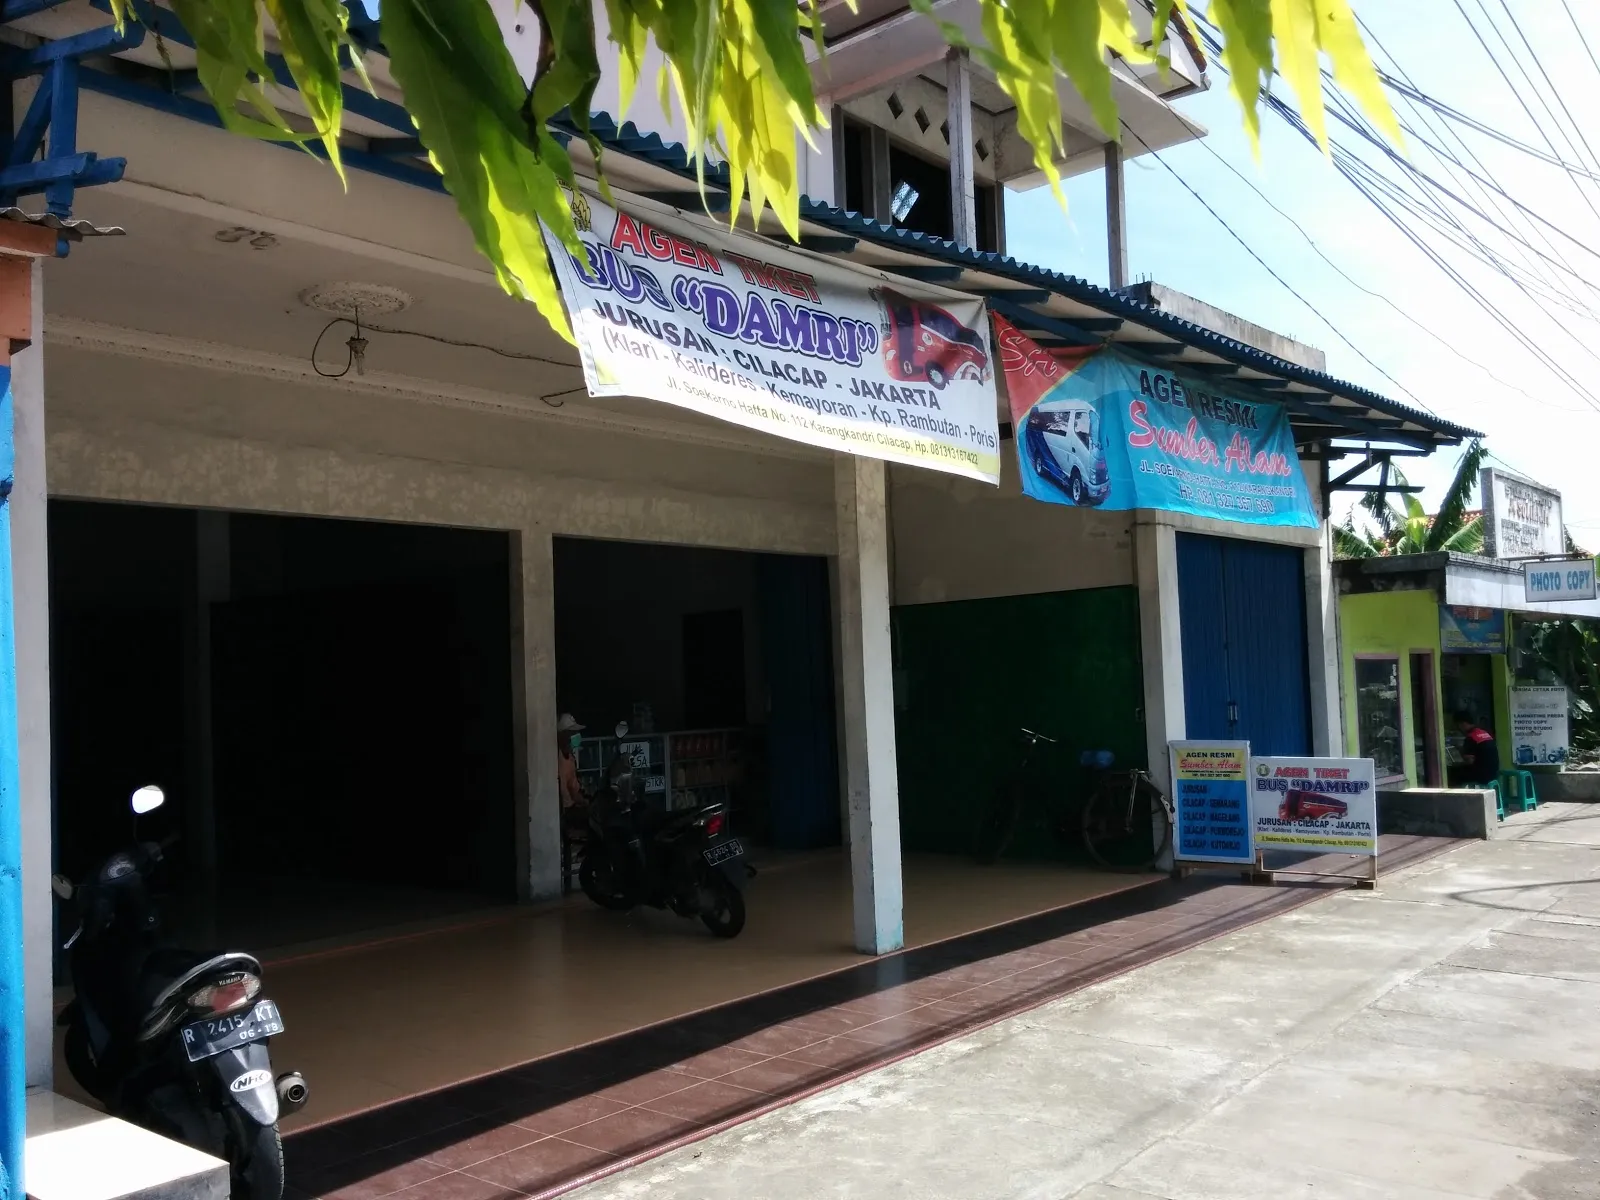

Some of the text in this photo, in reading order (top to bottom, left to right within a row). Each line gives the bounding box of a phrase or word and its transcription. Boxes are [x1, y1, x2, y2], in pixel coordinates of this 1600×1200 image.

[569, 240, 675, 312] BUS
[610, 209, 822, 305] AGEN TIKET
[592, 299, 718, 357] JURUSAN
[733, 349, 827, 389] CILACAP
[849, 377, 941, 410] JAKARTA
[602, 325, 659, 361] (Klari
[671, 350, 757, 391] Kalideres
[765, 381, 858, 418] Kemayoran
[868, 403, 895, 428] Kp.
[897, 408, 961, 438] Rambutan
[1139, 368, 1260, 430] AGEN RESMI
[685, 381, 737, 409] Soekarno
[738, 399, 768, 419] Hatta
[771, 407, 789, 423] No.
[790, 413, 808, 428] 112
[809, 420, 876, 442] Karangkandri
[877, 433, 913, 452] Cilacap,
[915, 439, 929, 455] Hp.
[1128, 399, 1292, 476] Sumber Alam
[1530, 570, 1590, 591] PHOTO COPY
[1180, 759, 1242, 769] Sumber Alam
[1256, 778, 1289, 792] BUS
[1274, 767, 1350, 779] AGEN TIKET
[1257, 818, 1291, 827] JURUSAN
[1298, 819, 1330, 828] CILACAP
[1336, 820, 1371, 830] JAKARTA
[219, 976, 241, 986] YAMAHA
[184, 1005, 273, 1043] R 2415 KT
